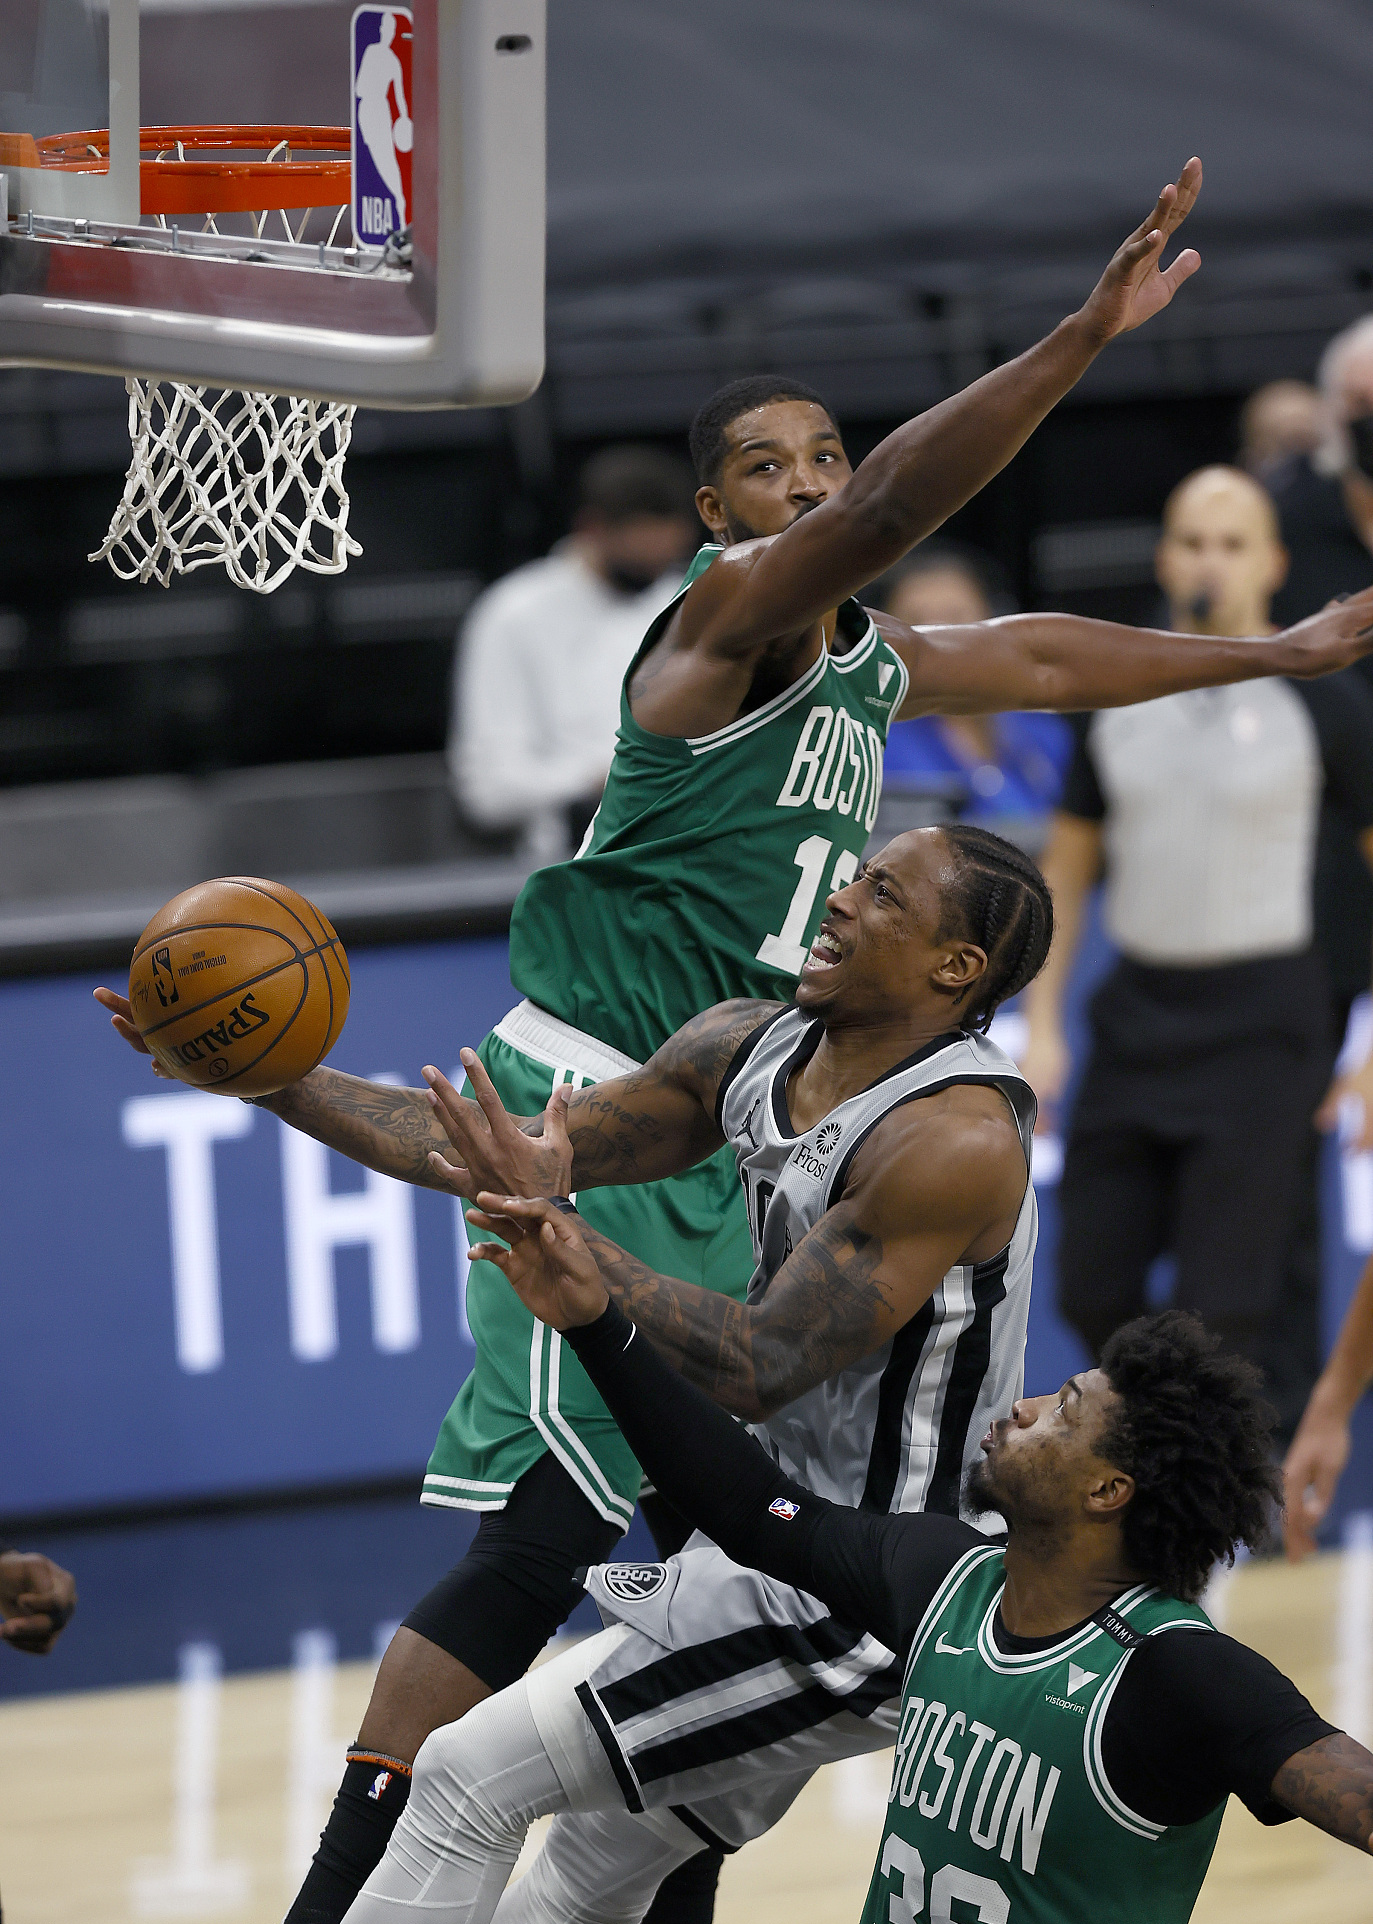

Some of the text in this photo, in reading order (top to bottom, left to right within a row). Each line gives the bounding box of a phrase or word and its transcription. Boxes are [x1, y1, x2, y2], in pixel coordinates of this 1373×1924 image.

[361, 195, 394, 236] NBA
[1102, 1613, 1134, 1644] TOMMY
[1045, 1694, 1086, 1715] vistaprint
[887, 1695, 1062, 1876] BOSTON
